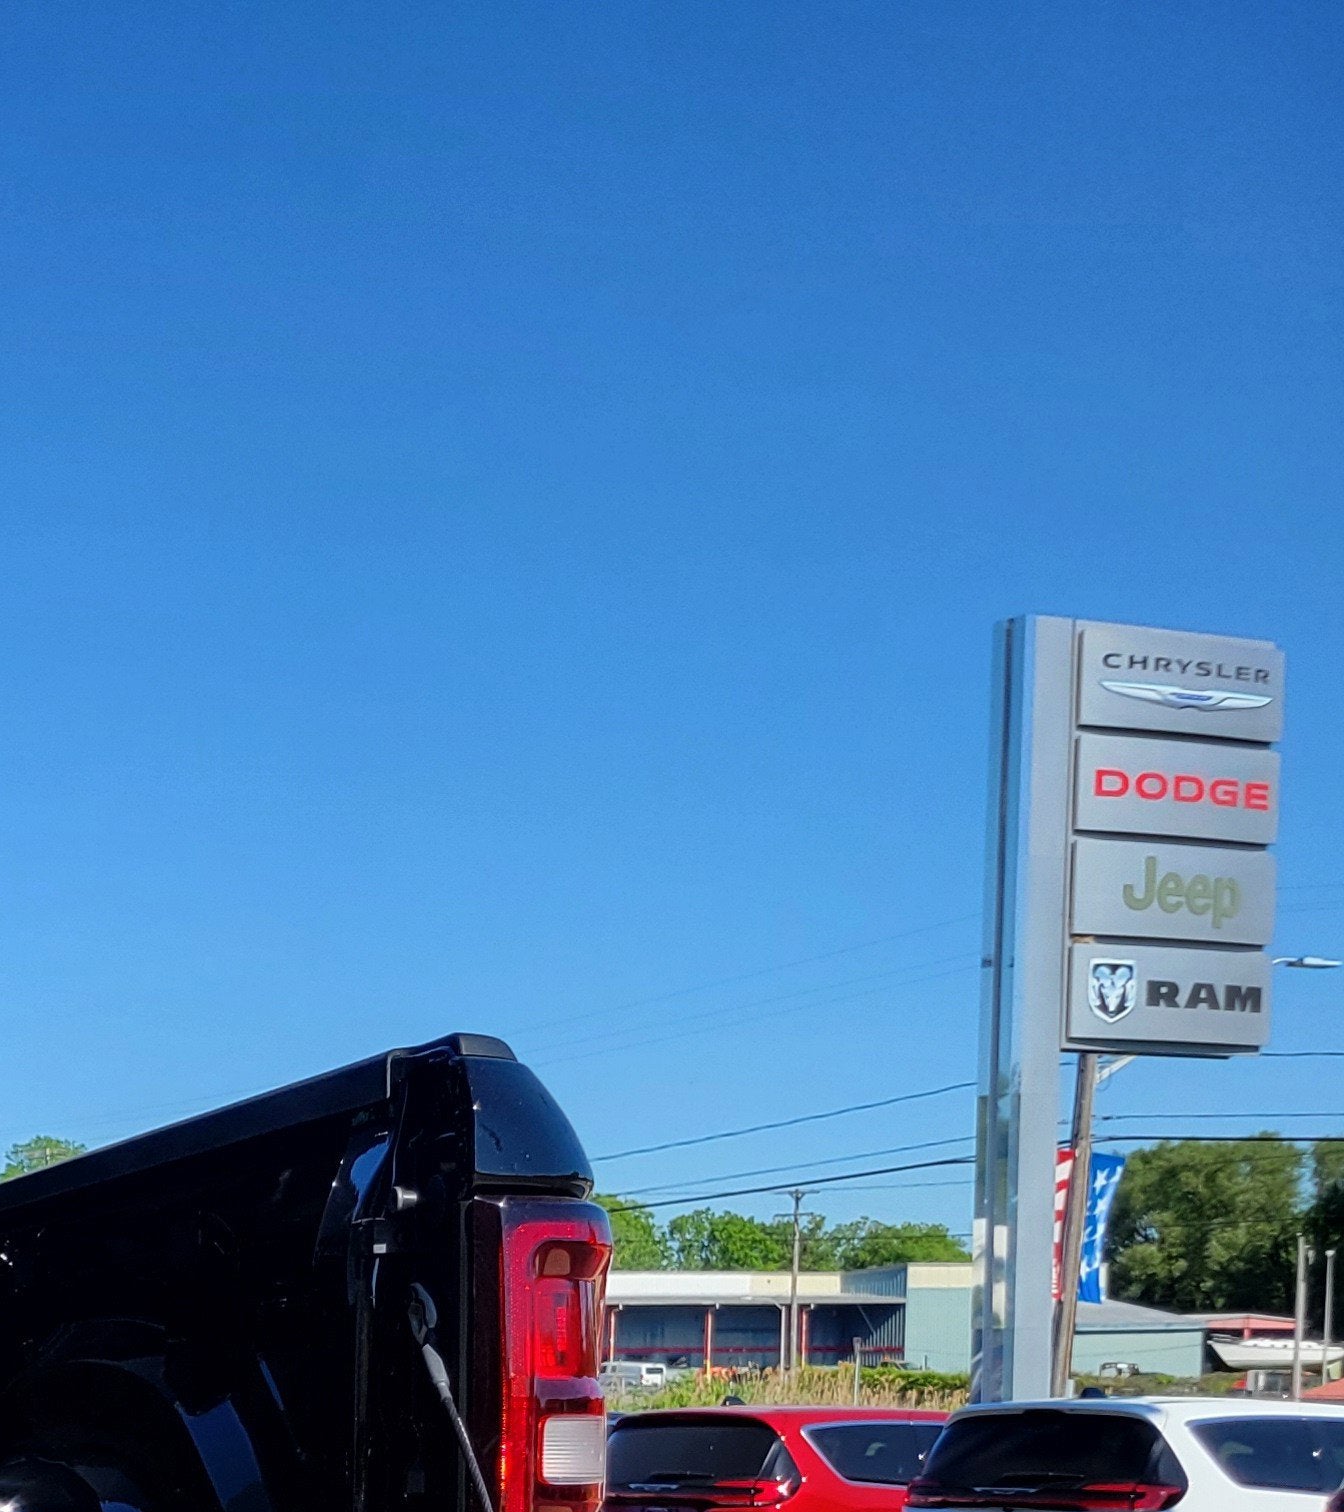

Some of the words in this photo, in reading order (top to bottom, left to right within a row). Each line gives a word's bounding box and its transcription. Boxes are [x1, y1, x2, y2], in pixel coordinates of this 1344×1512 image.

[1102, 652, 1270, 684] CHRYSLER
[1094, 769, 1269, 812] DODGE
[1123, 855, 1241, 929] Jeep
[1146, 980, 1262, 1013] RAM
